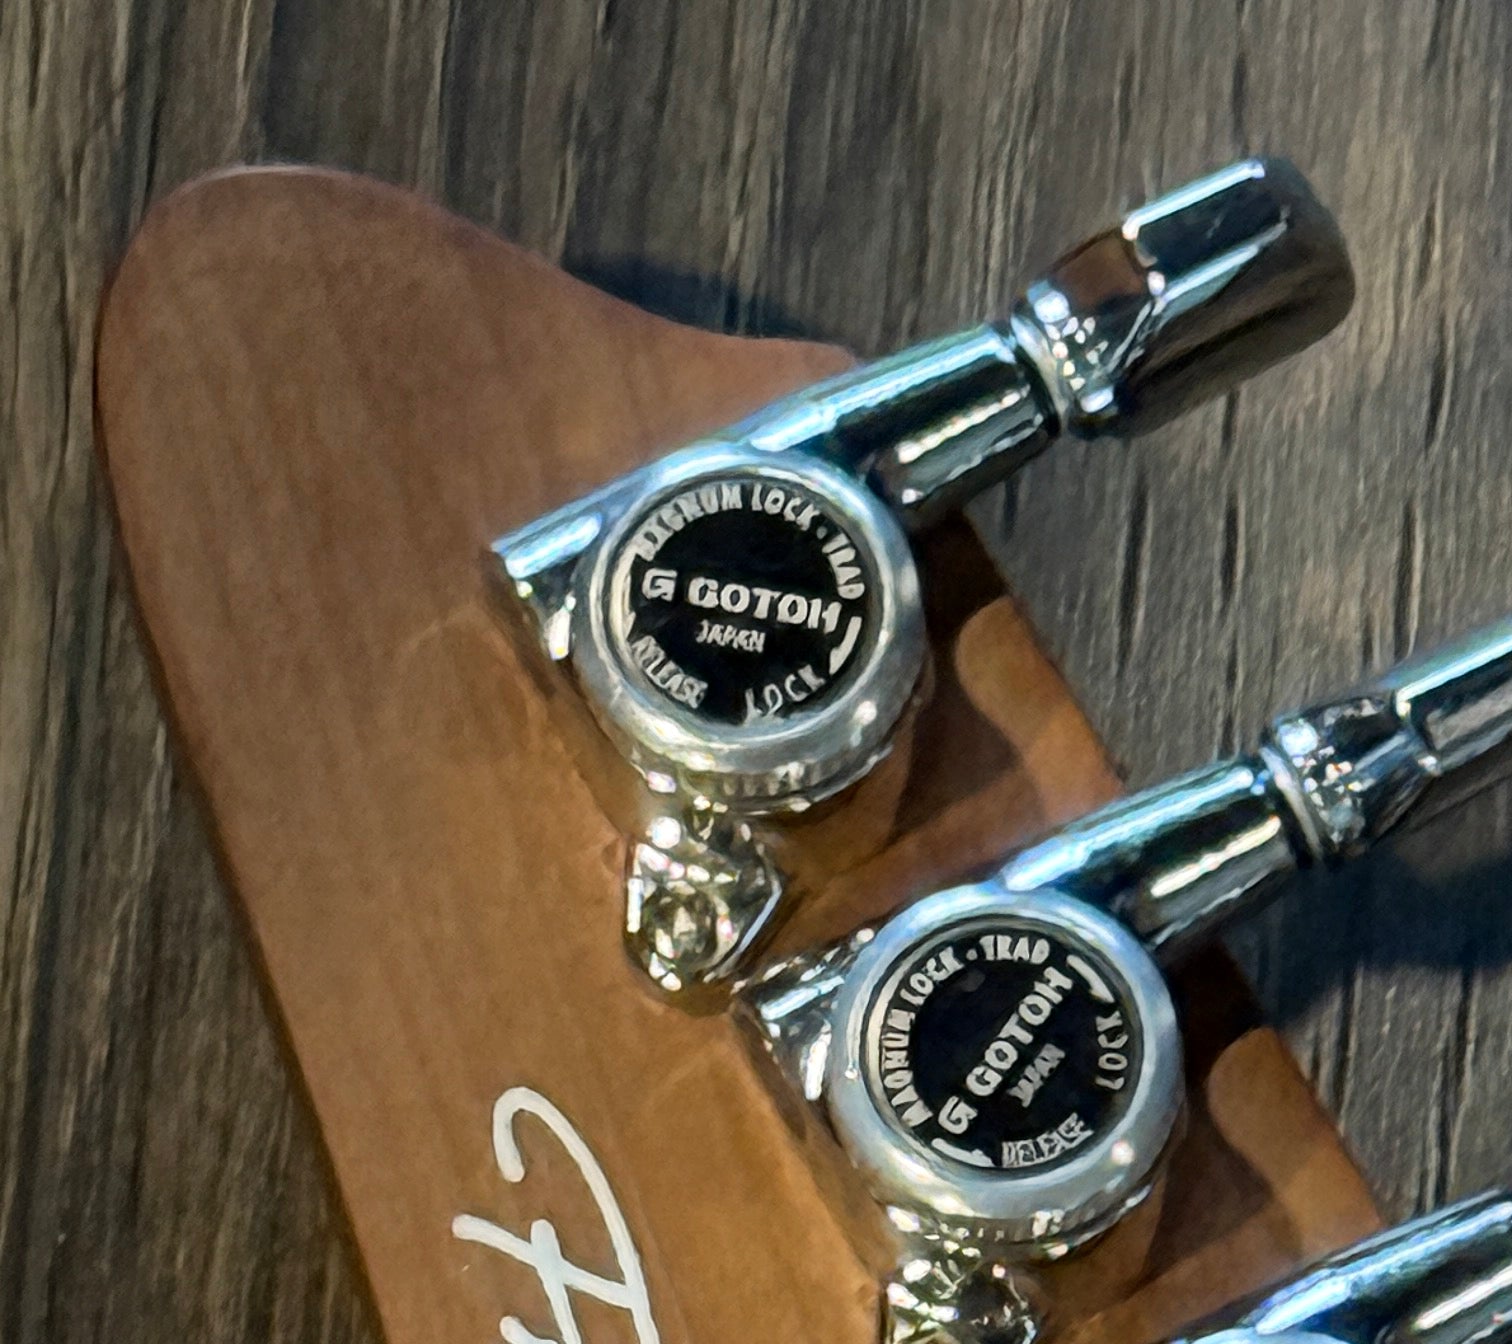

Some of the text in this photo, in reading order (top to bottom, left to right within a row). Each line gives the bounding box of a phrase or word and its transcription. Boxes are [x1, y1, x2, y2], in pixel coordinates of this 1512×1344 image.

[688, 577, 842, 634] GOTOH
[744, 664, 826, 726] LOCK
[966, 966, 1073, 1097] GOTOH
[1096, 1010, 1129, 1090] LOCK
